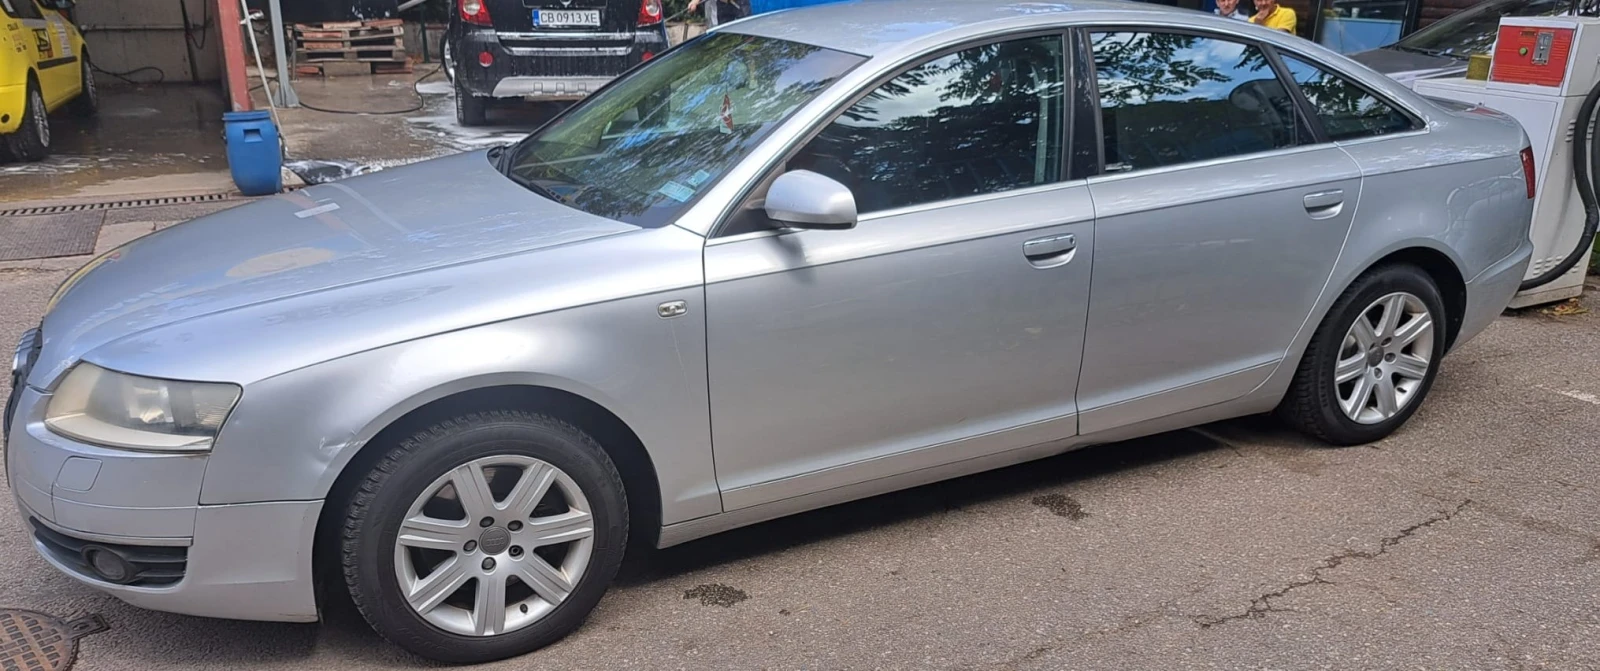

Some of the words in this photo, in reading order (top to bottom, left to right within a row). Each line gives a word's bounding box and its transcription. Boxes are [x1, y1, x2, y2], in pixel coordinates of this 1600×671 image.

[540, 12, 555, 23] CB
[556, 12, 582, 23] 0913
[584, 12, 598, 23] XE
